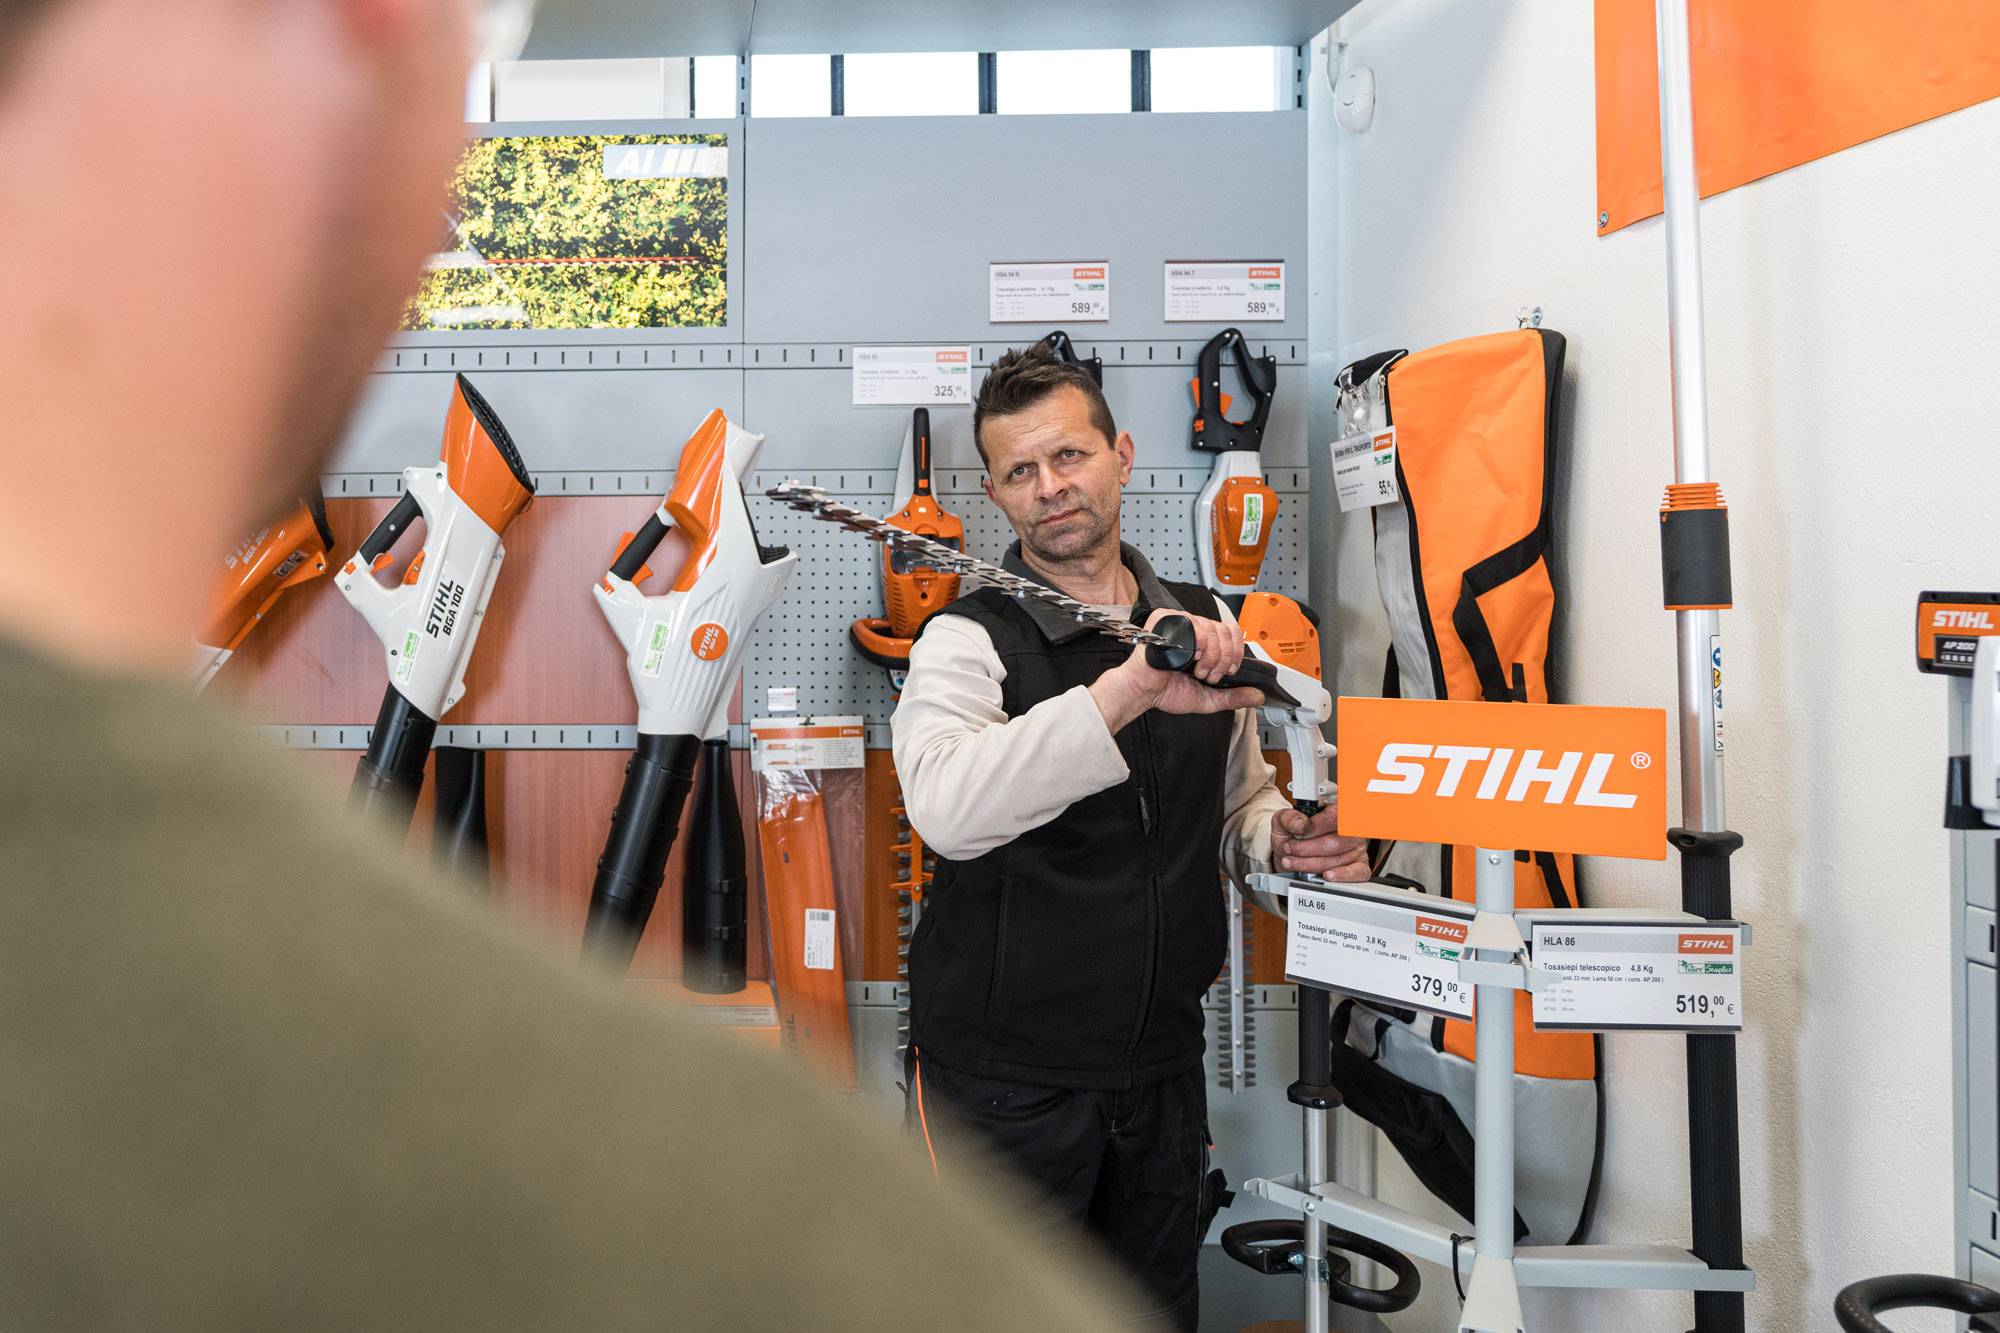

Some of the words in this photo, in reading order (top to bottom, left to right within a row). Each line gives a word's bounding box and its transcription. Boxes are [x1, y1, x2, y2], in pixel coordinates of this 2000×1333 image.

[1375, 437, 1391, 447] STIHL
[426, 580, 454, 638] STIHL
[442, 609, 457, 636] BGA
[451, 584, 465, 608] 100
[1932, 610, 1994, 629] STIHL
[698, 626, 715, 658] STIHL
[1943, 641, 1957, 650] AP
[1366, 742, 1638, 809] STIHL
[1298, 898, 1315, 909] HLA
[1316, 900, 1326, 911] 66
[1298, 921, 1328, 935] Tosasiepi
[1328, 926, 1358, 941] allungato
[1377, 937, 1387, 948] Kg
[1418, 923, 1464, 938] STIHL
[1543, 937, 1562, 946] HLA
[1565, 937, 1576, 946] 86
[1681, 939, 1728, 949] STIHL
[1543, 963, 1578, 973] Tosasiepi
[1579, 964, 1621, 974] telescopico
[1642, 965, 1653, 974] Kg
